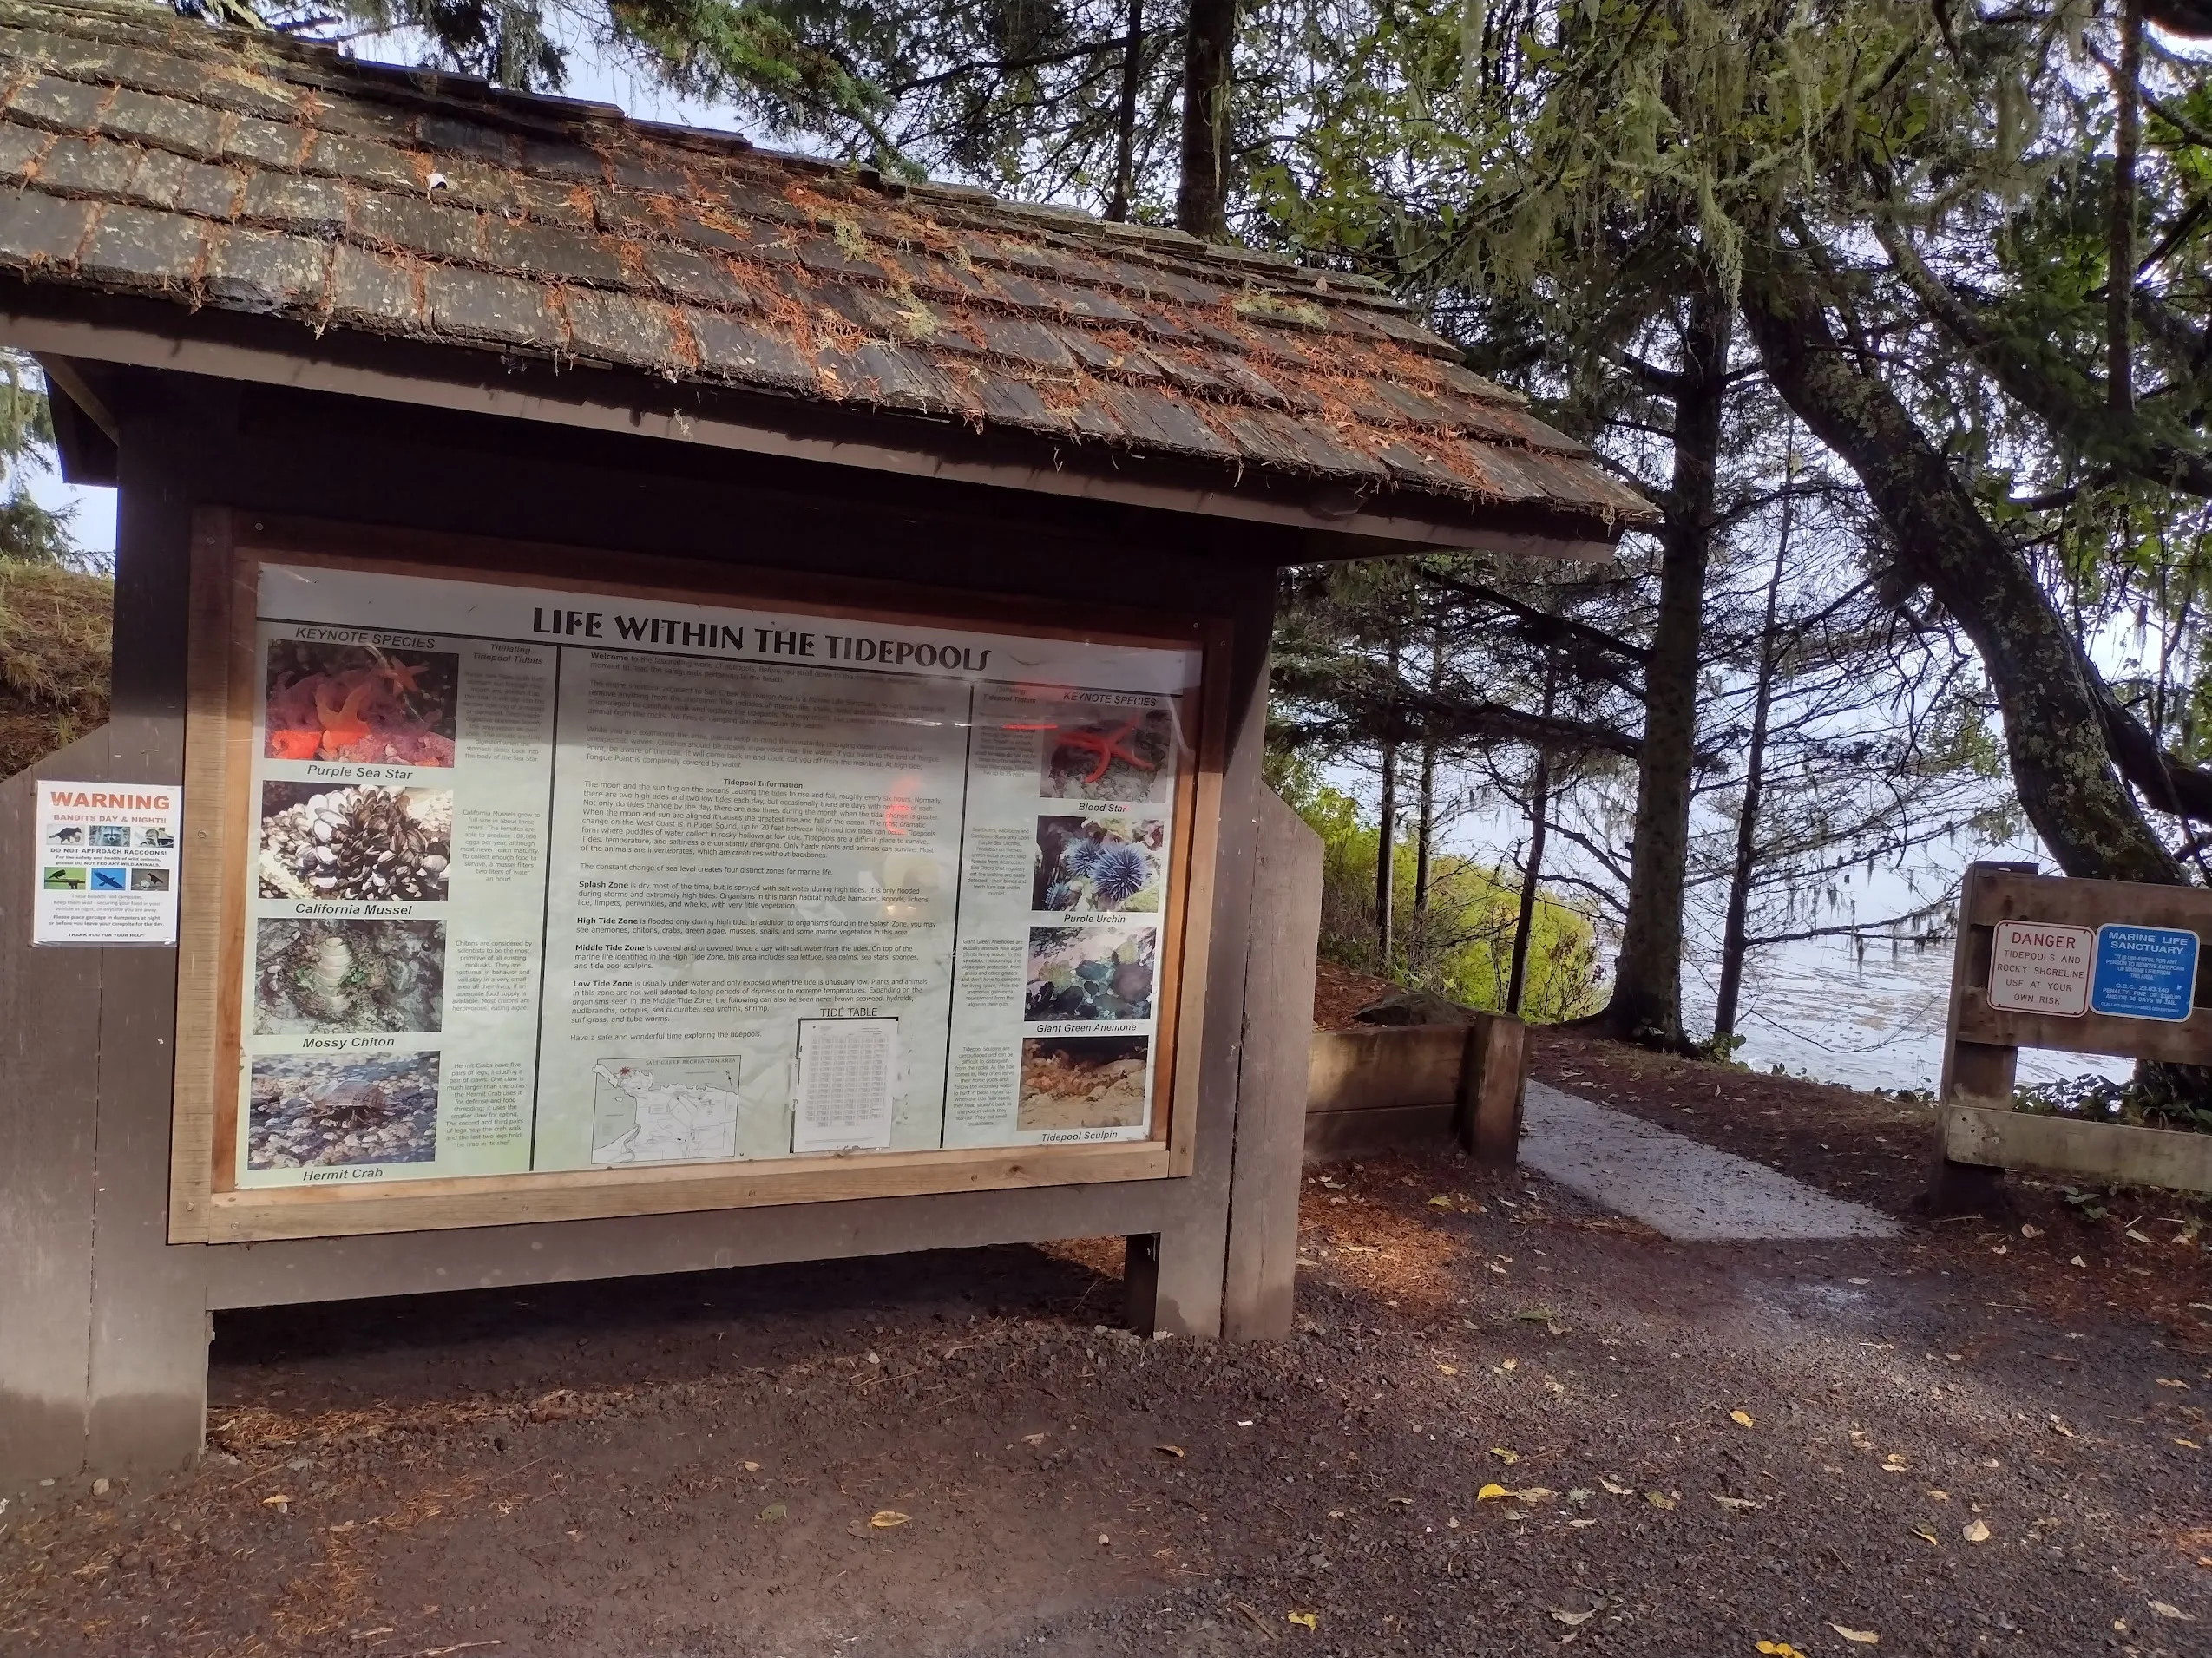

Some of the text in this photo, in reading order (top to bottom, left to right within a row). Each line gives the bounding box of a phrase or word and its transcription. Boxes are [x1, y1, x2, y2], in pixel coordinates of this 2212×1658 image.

[295, 627, 436, 648] KEYNOTE SPECIES
[534, 607, 992, 672] LIFE WITHIN THE TIDEPOOLS
[491, 643, 530, 654] Titillating
[473, 652, 543, 665] Tidepool Tidbits
[1063, 692, 1157, 706] KEYNOTE SPECIES
[307, 764, 412, 779] Purple Sea Star
[724, 778, 756, 787] Tidepool
[51, 791, 169, 809] WARNING
[1078, 803, 1126, 812] Blood Star
[295, 903, 412, 914] California Mussel
[1064, 914, 1093, 924] Purple
[2012, 932, 2076, 949] DANGER
[2109, 932, 2188, 945] MARINE LIFE
[2110, 941, 2184, 954] SANCTUARY
[2005, 949, 2080, 964] TIDEPOOLS AND
[1997, 963, 2084, 979] ROCKY SHORELINE
[2005, 978, 2024, 987] USE
[2047, 982, 2071, 992] YOUR
[2013, 993, 2060, 1005] OWN RISK
[819, 1006, 877, 1017] TIDE TABLE
[302, 1037, 394, 1050] Mossy Chiton
[1042, 1130, 1117, 1141] Tidepool Sculpin
[303, 1168, 383, 1180] Hermit Crab
